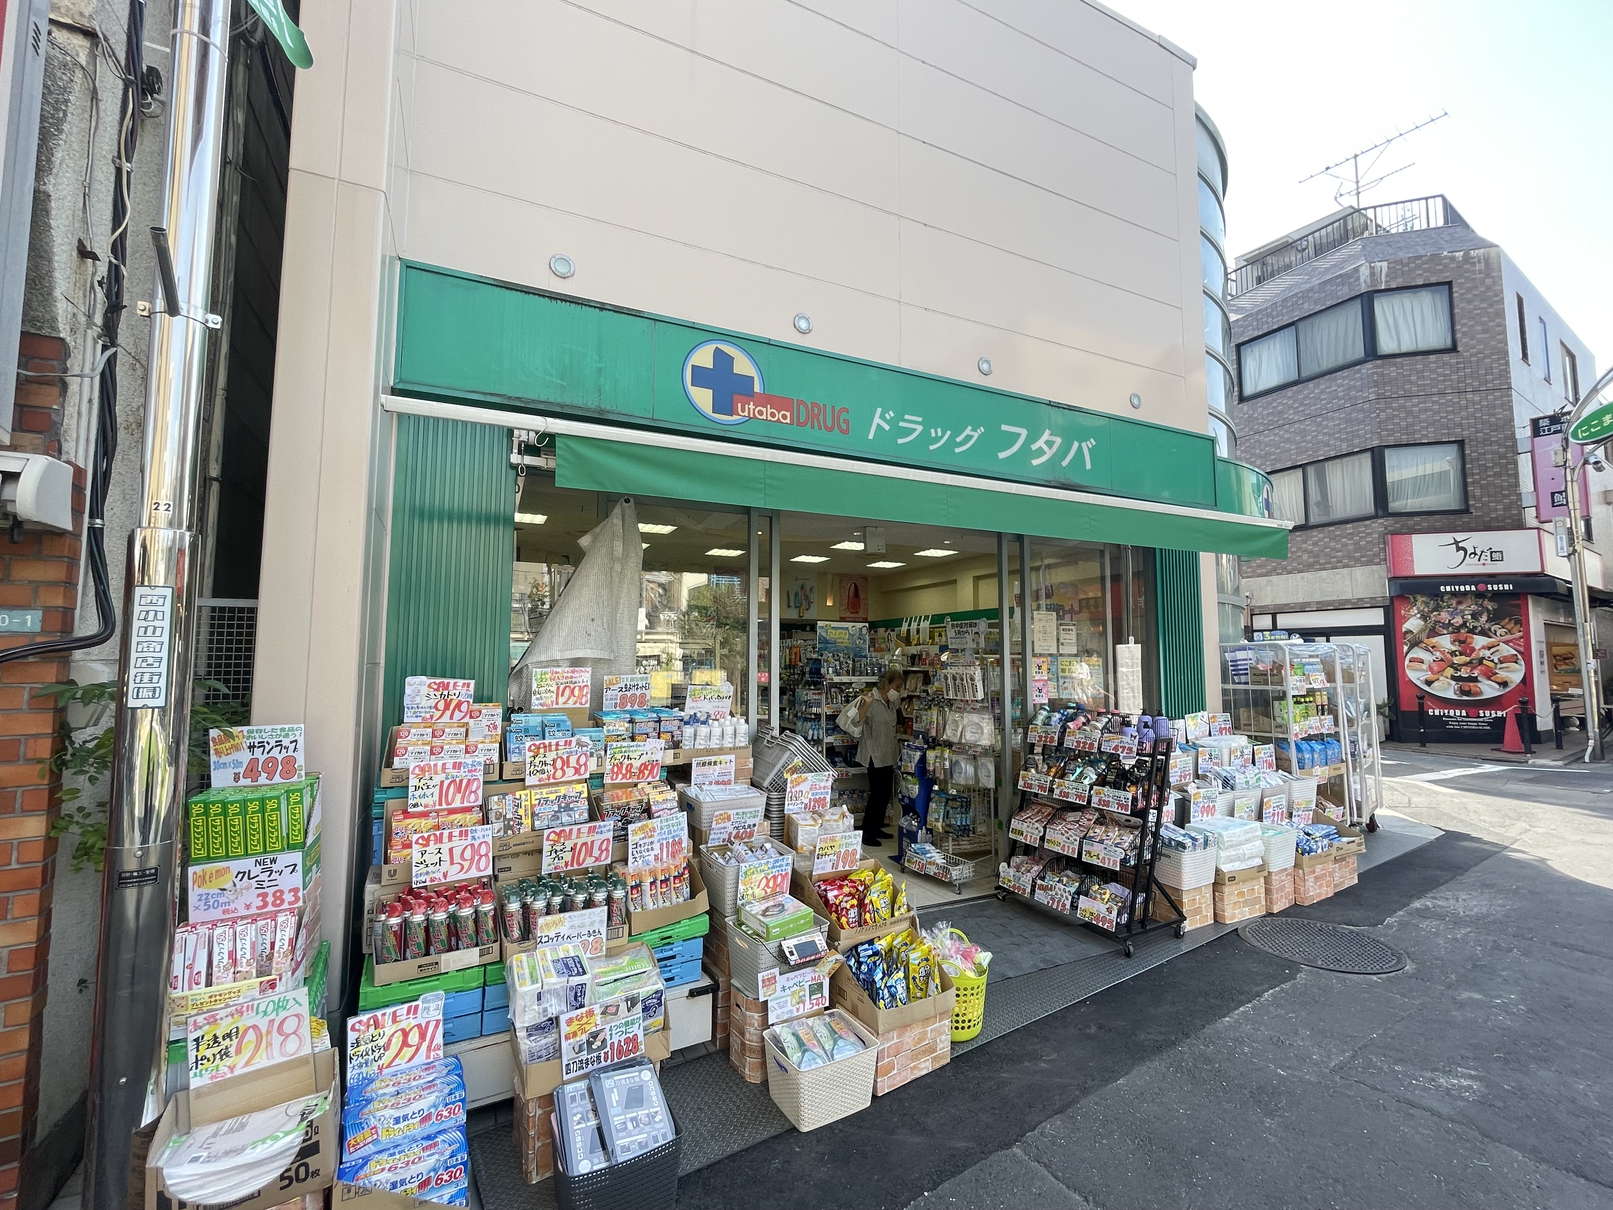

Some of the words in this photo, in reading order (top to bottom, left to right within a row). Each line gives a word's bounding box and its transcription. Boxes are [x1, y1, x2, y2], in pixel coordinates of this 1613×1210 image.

[737, 402, 791, 425] utaba
[795, 401, 849, 435] DRUG
[867, 408, 985, 453] ドラッグ
[998, 424, 1097, 470] フタバ
[247, 739, 299, 756] サランラップ
[255, 857, 278, 867] NEW
[418, 848, 443, 859] アース
[235, 863, 298, 881] クレラップ
[254, 879, 279, 890] ミニ
[435, 1103, 462, 1122] 630
[434, 1167, 465, 1187] 630
